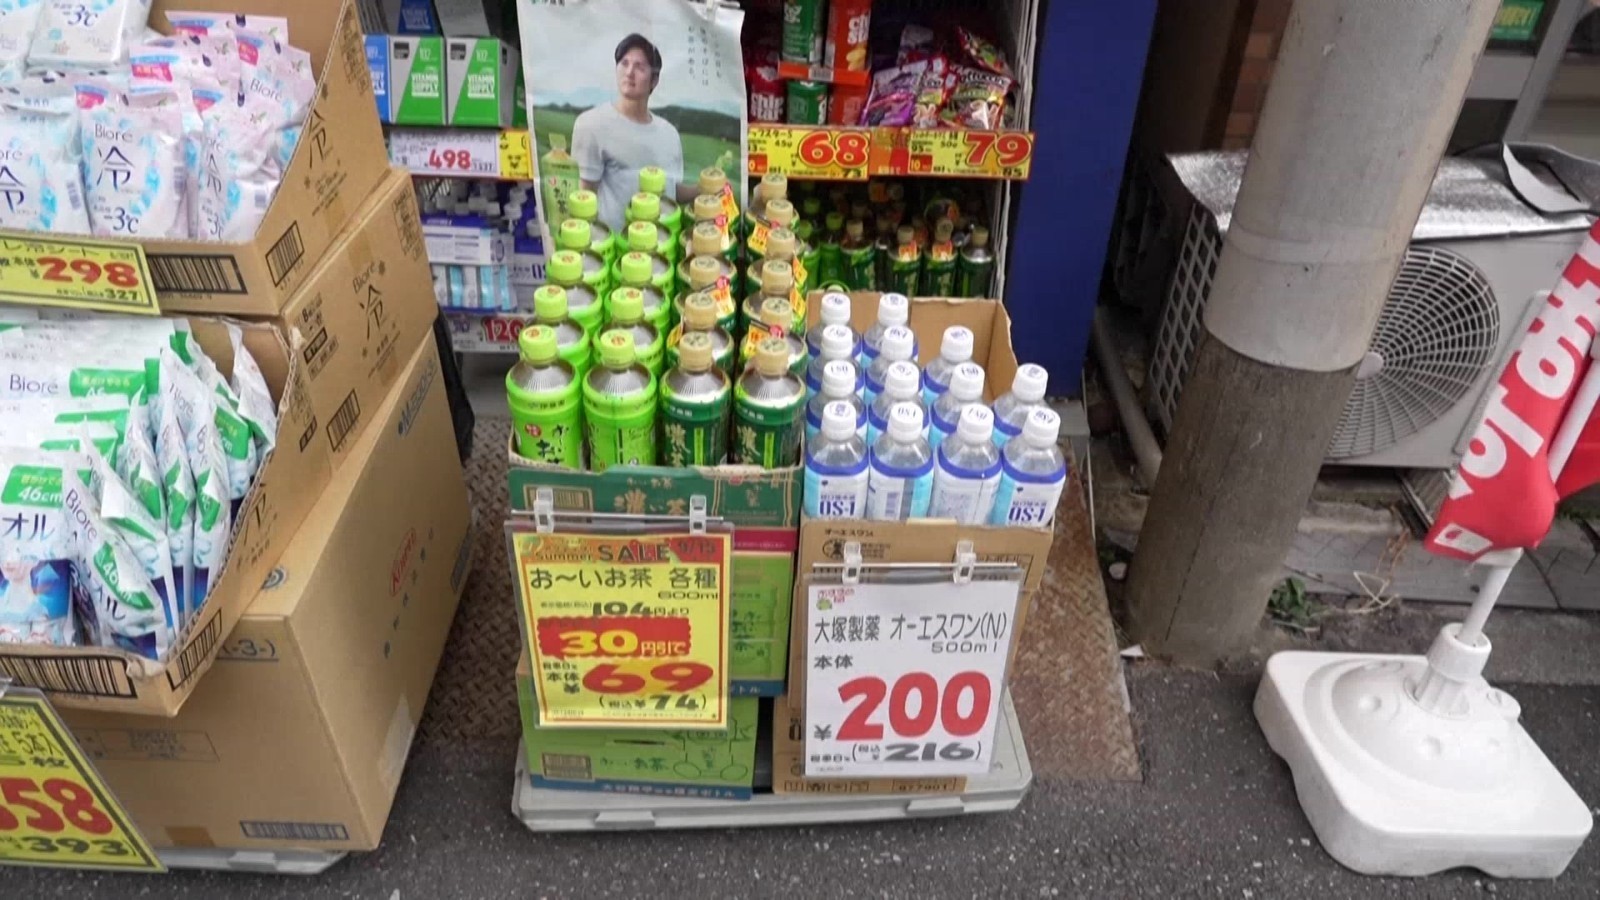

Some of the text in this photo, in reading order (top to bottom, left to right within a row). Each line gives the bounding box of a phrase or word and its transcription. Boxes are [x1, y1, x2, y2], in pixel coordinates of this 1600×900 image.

[428, 148, 471, 169] 498
[798, 130, 869, 168] 68
[964, 131, 1032, 168] 79
[96, 145, 137, 192] 冷
[36, 255, 140, 289] 298
[359, 284, 384, 339] 冷
[819, 500, 856, 516] OS-1
[1008, 506, 1046, 523] OS-1
[2, 512, 56, 542] オル
[824, 528, 874, 537] オーエスワン
[597, 543, 671, 562] SALE
[669, 567, 717, 589] 各種
[657, 591, 719, 600] 600ml
[814, 611, 1007, 644] 大塚製薬 オーエスワン(N)
[931, 641, 998, 654] 500ml
[813, 654, 854, 670] 本体
[546, 672, 580, 682] 本体
[582, 662, 715, 694] 69
[813, 670, 992, 741] ¥ 200
